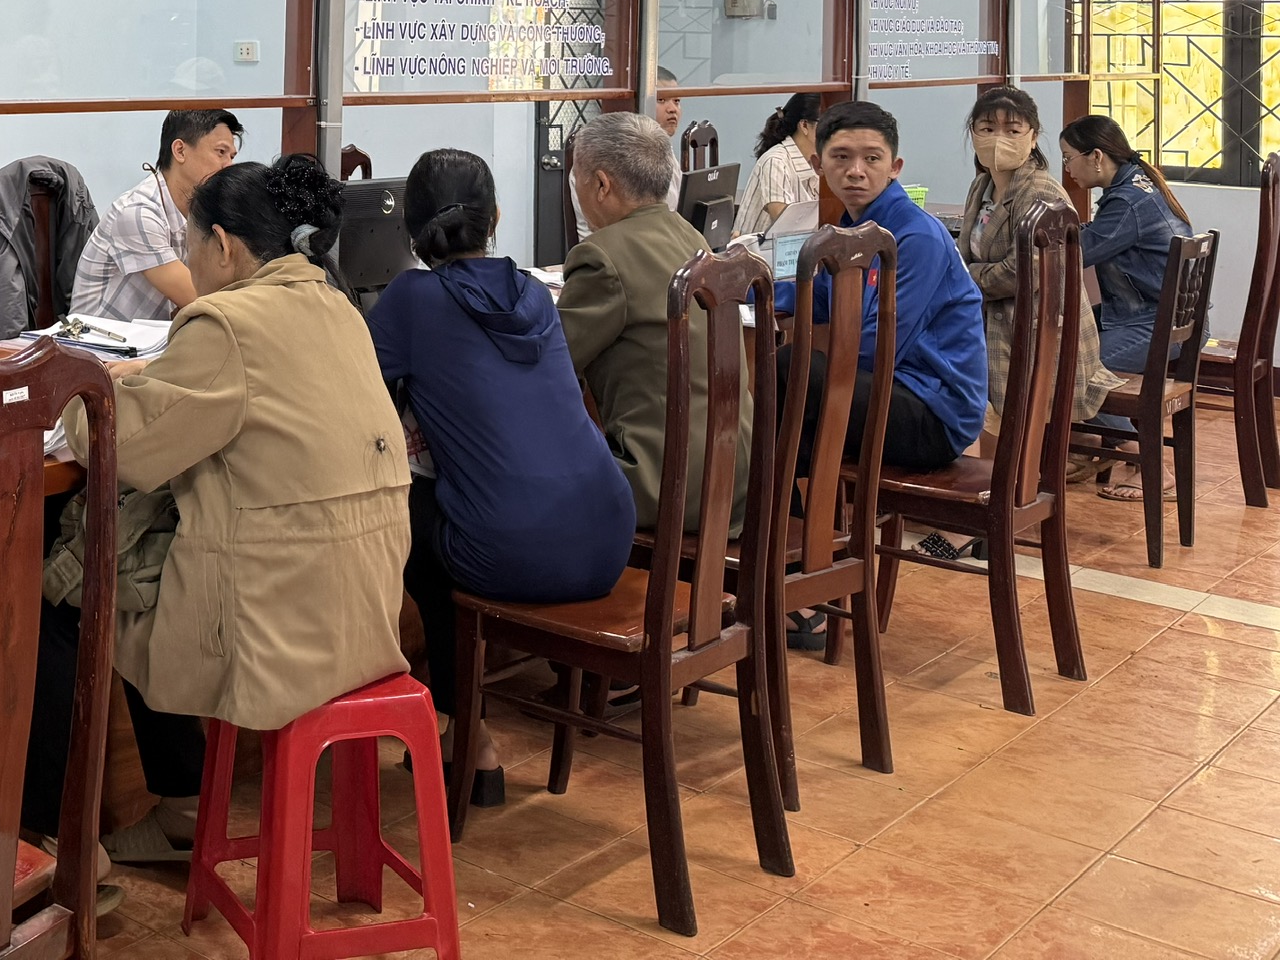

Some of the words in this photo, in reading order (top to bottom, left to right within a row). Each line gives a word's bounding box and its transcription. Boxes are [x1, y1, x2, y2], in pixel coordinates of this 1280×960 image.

[363, 17, 395, 40] LĨNH
[399, 20, 427, 44] VỰC
[429, 18, 457, 41] XÂY
[460, 22, 496, 46] DỰNG
[499, 20, 515, 42] VÀ
[517, 22, 552, 43] CÔNG
[363, 53, 395, 76] LĨNH
[399, 55, 427, 79] VỰC
[428, 53, 466, 76] NÔNG
[471, 55, 518, 79] NGHIỆP
[521, 54, 539, 76] VÀ
[539, 54, 560, 76] MÔI
